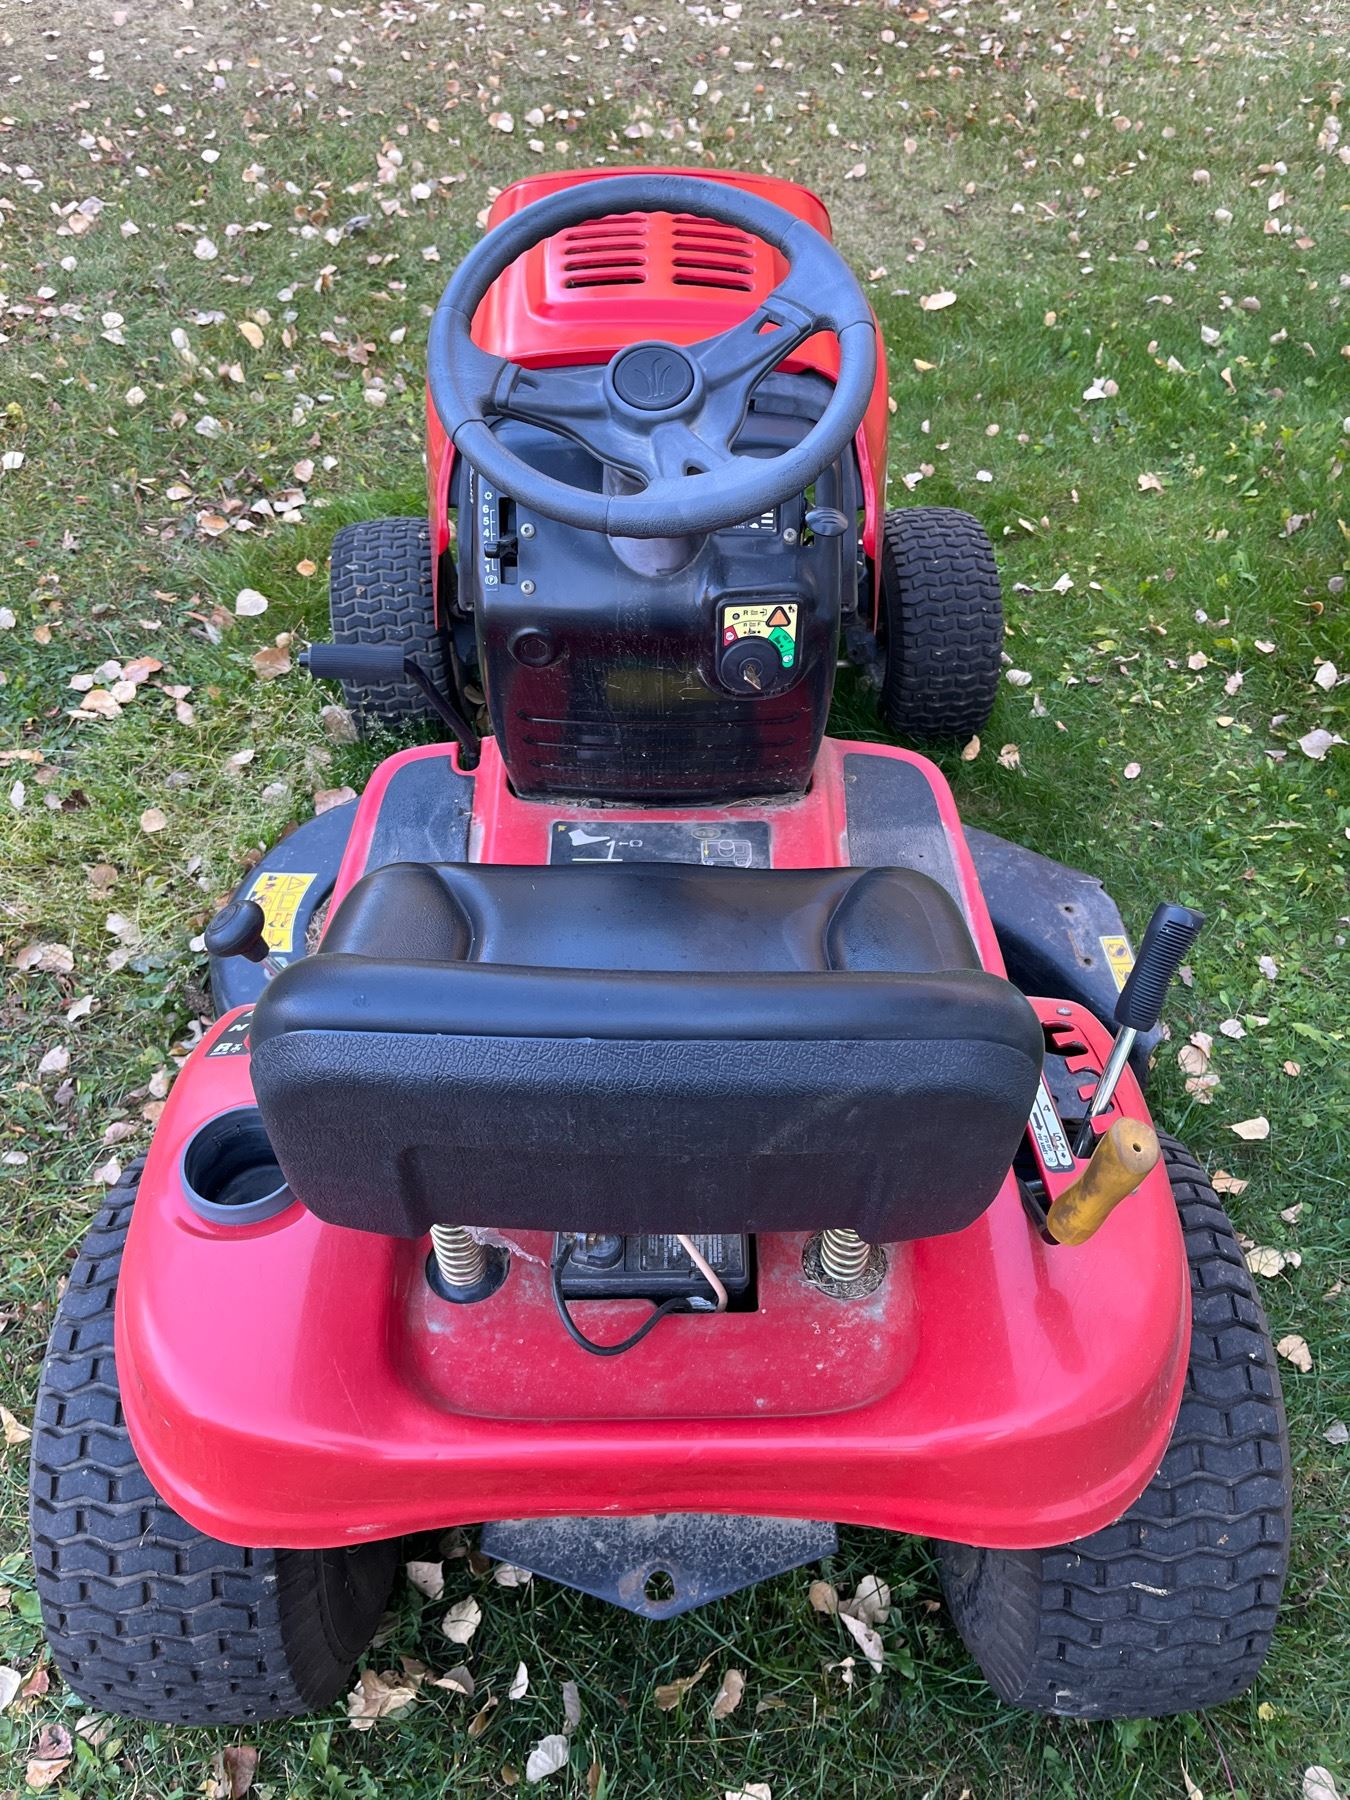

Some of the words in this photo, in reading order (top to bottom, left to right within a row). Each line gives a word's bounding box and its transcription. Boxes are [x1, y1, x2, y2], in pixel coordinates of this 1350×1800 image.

[482, 504, 490, 514] 6
[482, 516, 490, 526] 5
[483, 528, 490, 538] 4
[484, 563, 490, 573] 1
[228, 1023, 250, 1032] N
[213, 1042, 233, 1053] R
[1043, 1104, 1051, 1113] 4
[1052, 1132, 1062, 1142] 5
